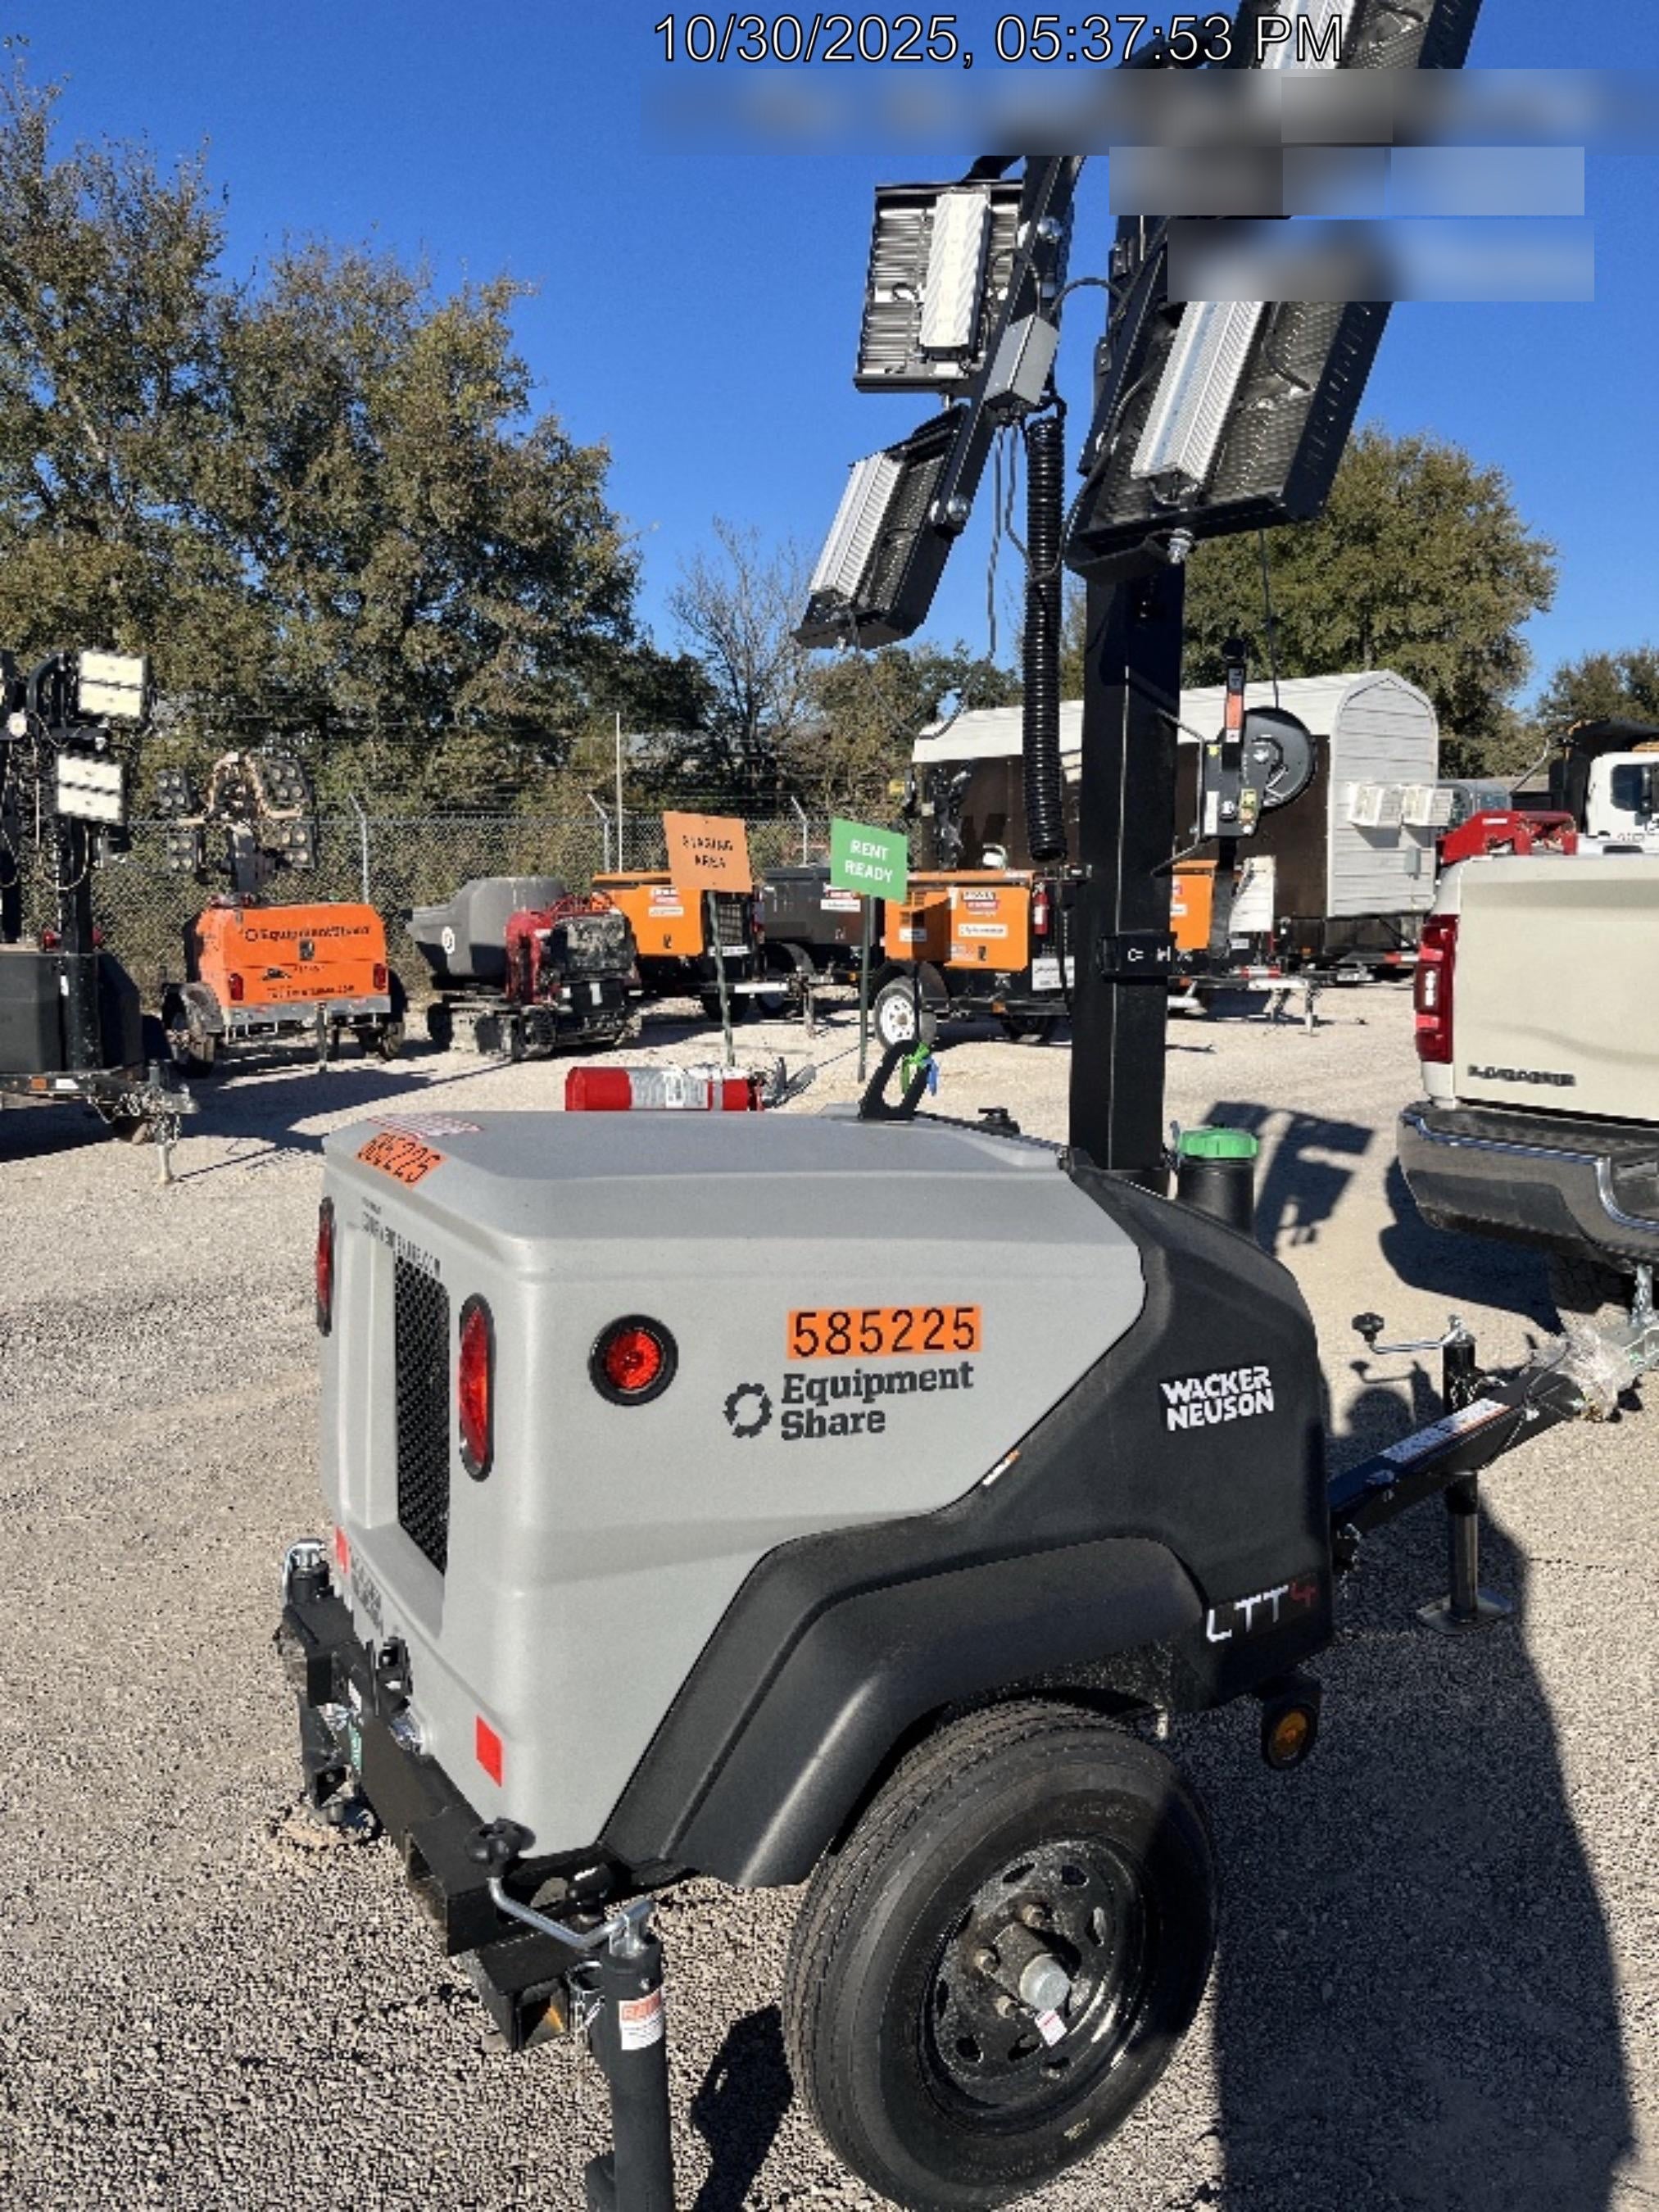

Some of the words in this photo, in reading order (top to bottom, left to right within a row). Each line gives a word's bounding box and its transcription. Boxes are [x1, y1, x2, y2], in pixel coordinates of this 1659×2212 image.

[850, 839, 890, 861] RENT
[845, 859, 893, 883] READY
[792, 1307, 975, 1358] 585225
[781, 1361, 974, 1407] Equipment
[1159, 1366, 1271, 1405] WACKER
[781, 1408, 886, 1441] Share
[1167, 1388, 1275, 1432] NEUSON
